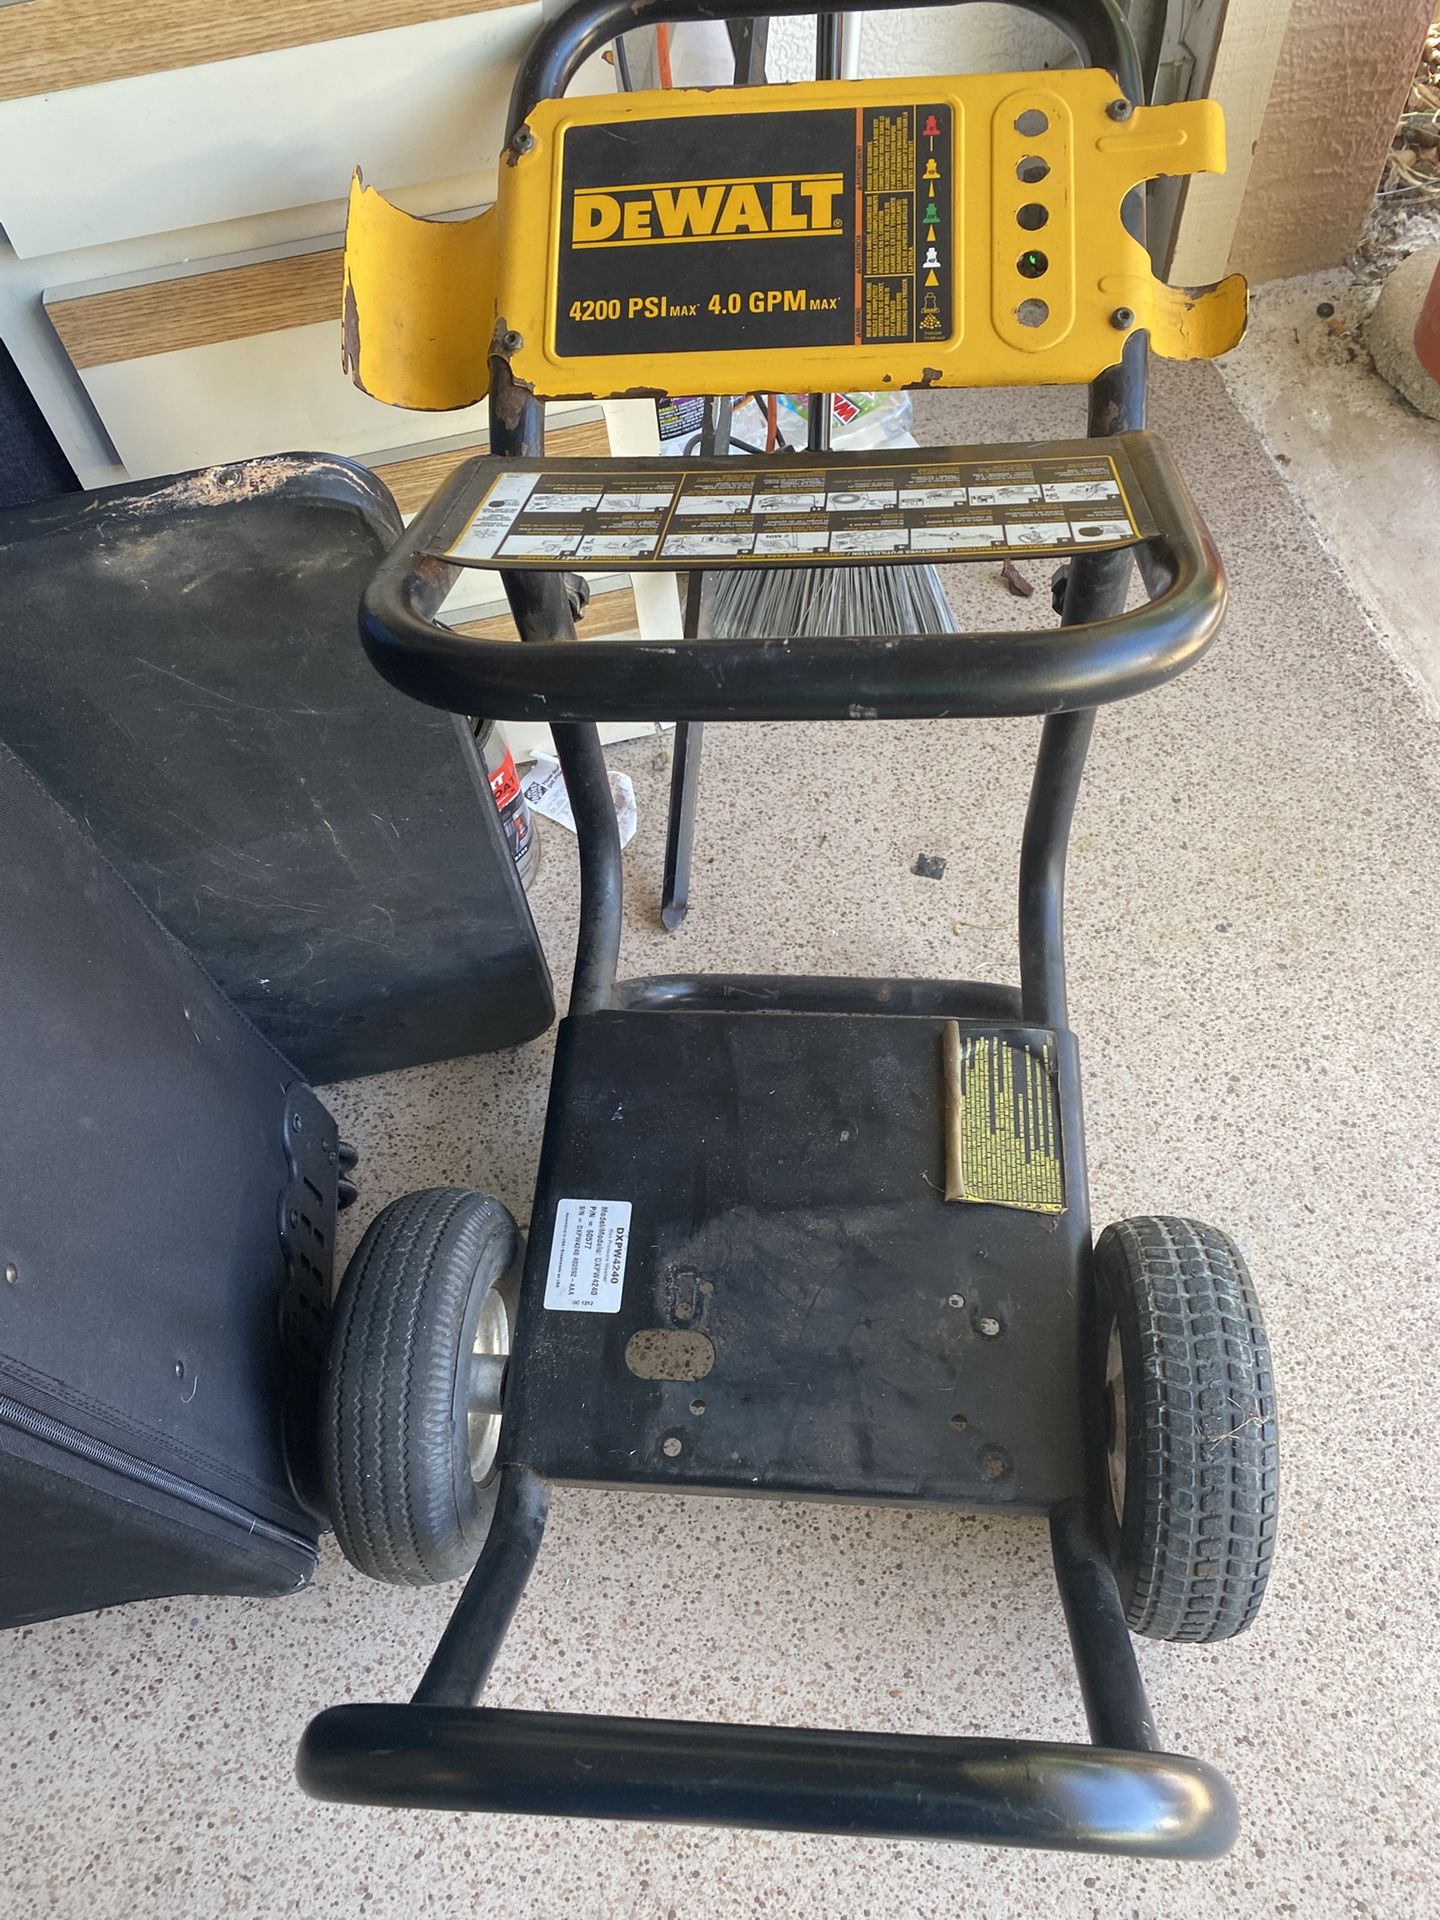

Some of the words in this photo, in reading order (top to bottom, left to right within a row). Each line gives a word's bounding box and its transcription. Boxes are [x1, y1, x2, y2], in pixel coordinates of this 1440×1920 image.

[569, 299, 621, 321] 4200
[628, 296, 667, 319] PSI
[708, 293, 741, 315] 4.0
[749, 289, 807, 313] GPM
[588, 1206, 597, 1218] P/N
[610, 1227, 624, 1284] DXPW4240
[590, 1258, 602, 1296] DXPW4240
